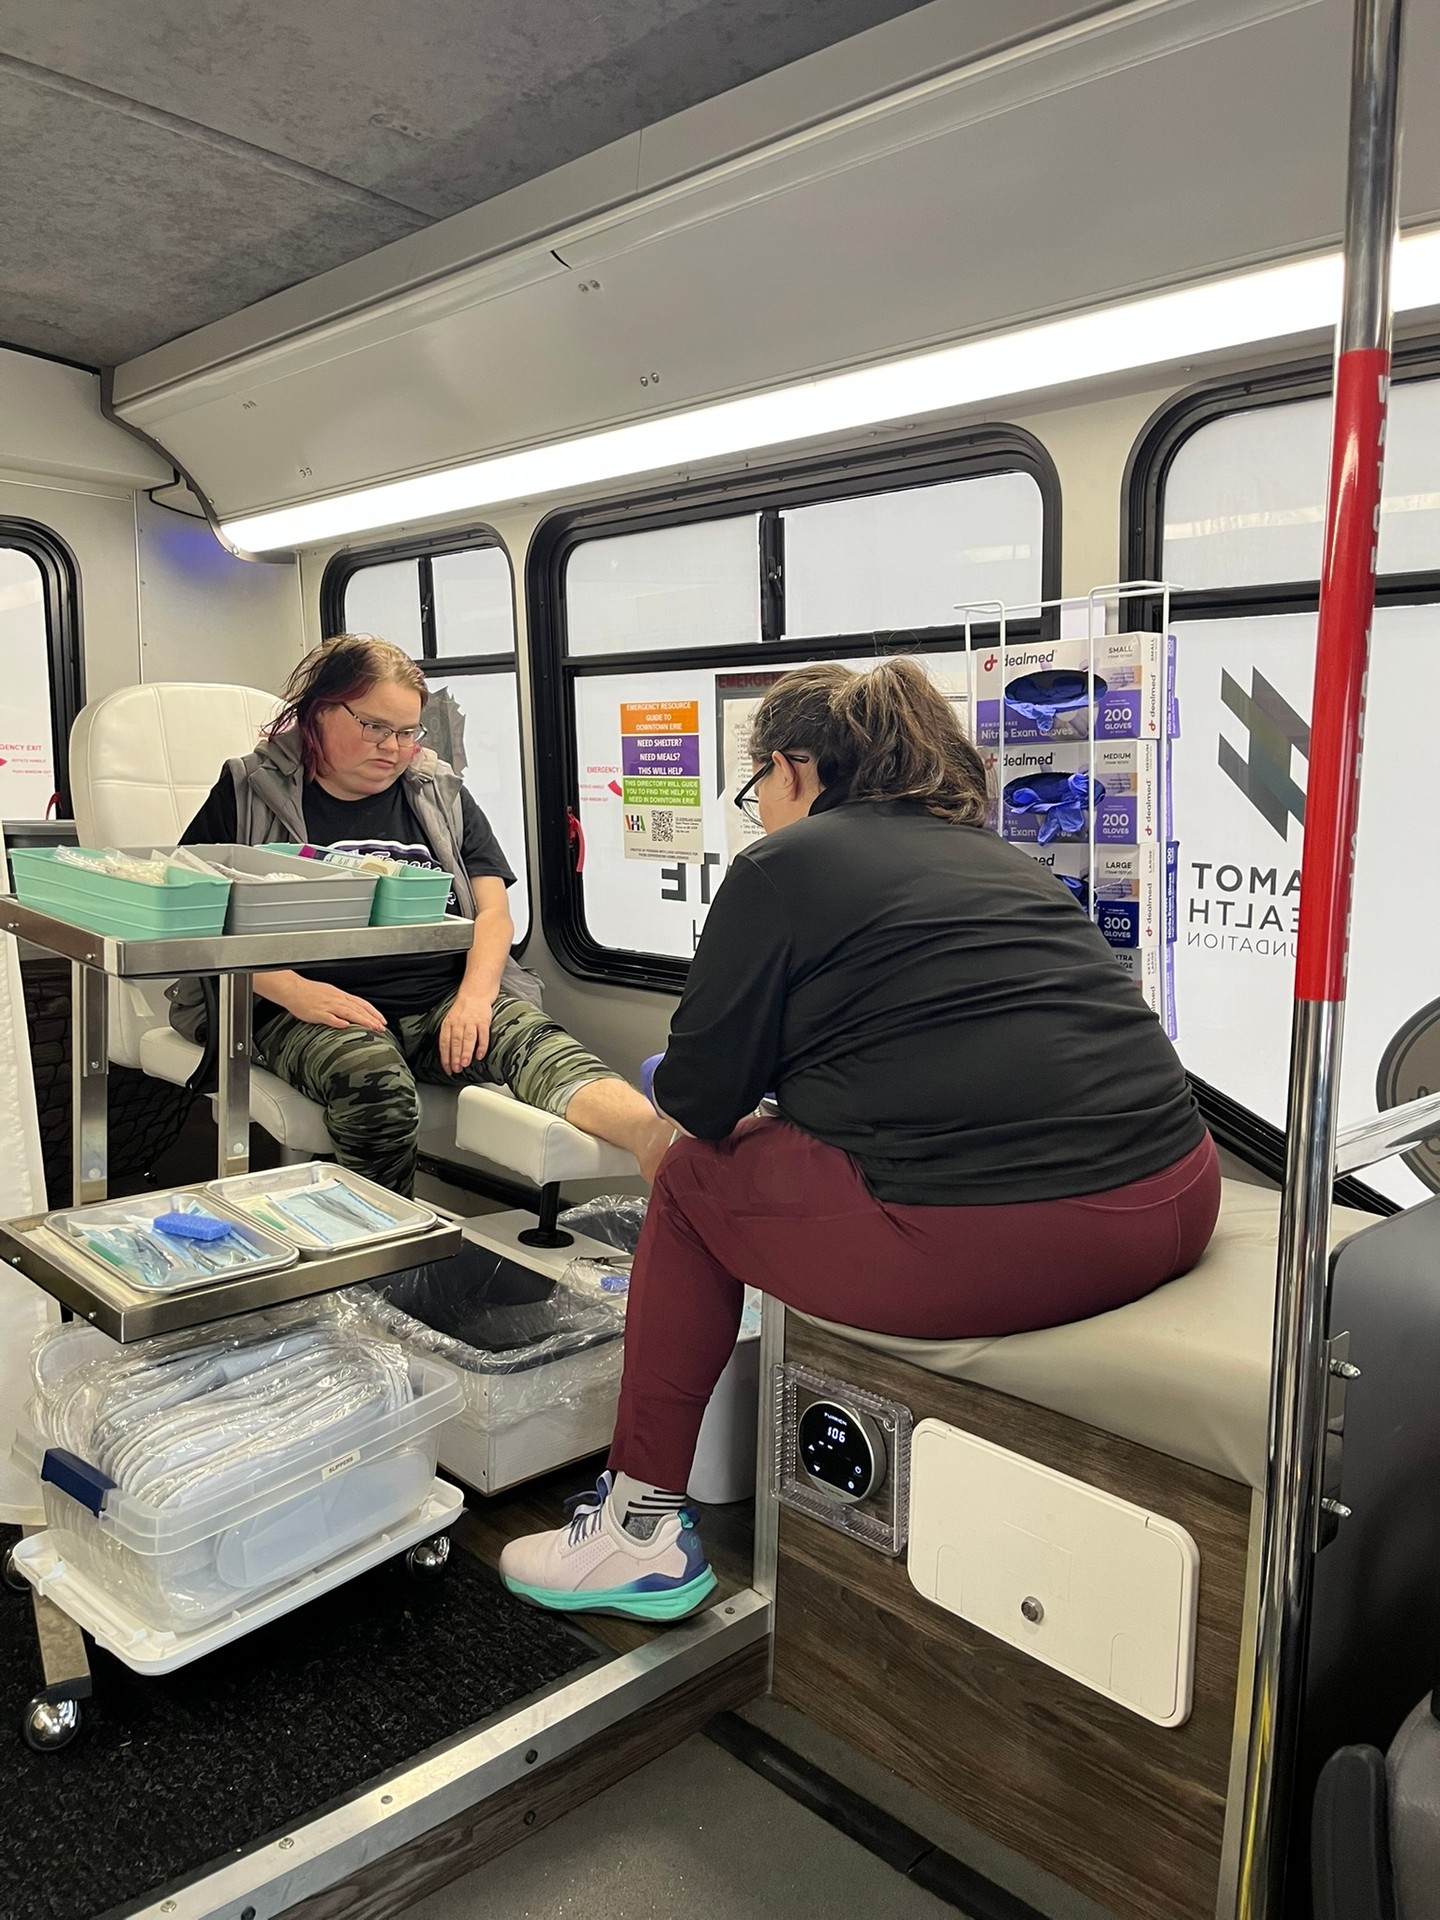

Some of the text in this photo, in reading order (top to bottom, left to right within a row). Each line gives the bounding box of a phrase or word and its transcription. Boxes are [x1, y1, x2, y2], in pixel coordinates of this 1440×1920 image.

[1108, 646, 1133, 654] SMALL
[626, 703, 660, 711] EMERGENCY
[1104, 707, 1132, 722] 200
[636, 723, 668, 731] DOWNTOWN
[1104, 722, 1132, 730] GLOVES
[982, 727, 1073, 739] Nitre Exam Goves
[637, 738, 682, 747] NEED SHELTER?
[640, 752, 680, 761] NEED MEALS?
[1003, 752, 1053, 766] dealmed
[638, 767, 651, 775] THIS
[1102, 814, 1129, 826] 200
[1011, 827, 1036, 837] Exam
[1103, 827, 1129, 835] GLOVES
[1104, 917, 1131, 930] 300
[1104, 930, 1131, 938] GLOVES
[828, 1426, 846, 1443] 106
